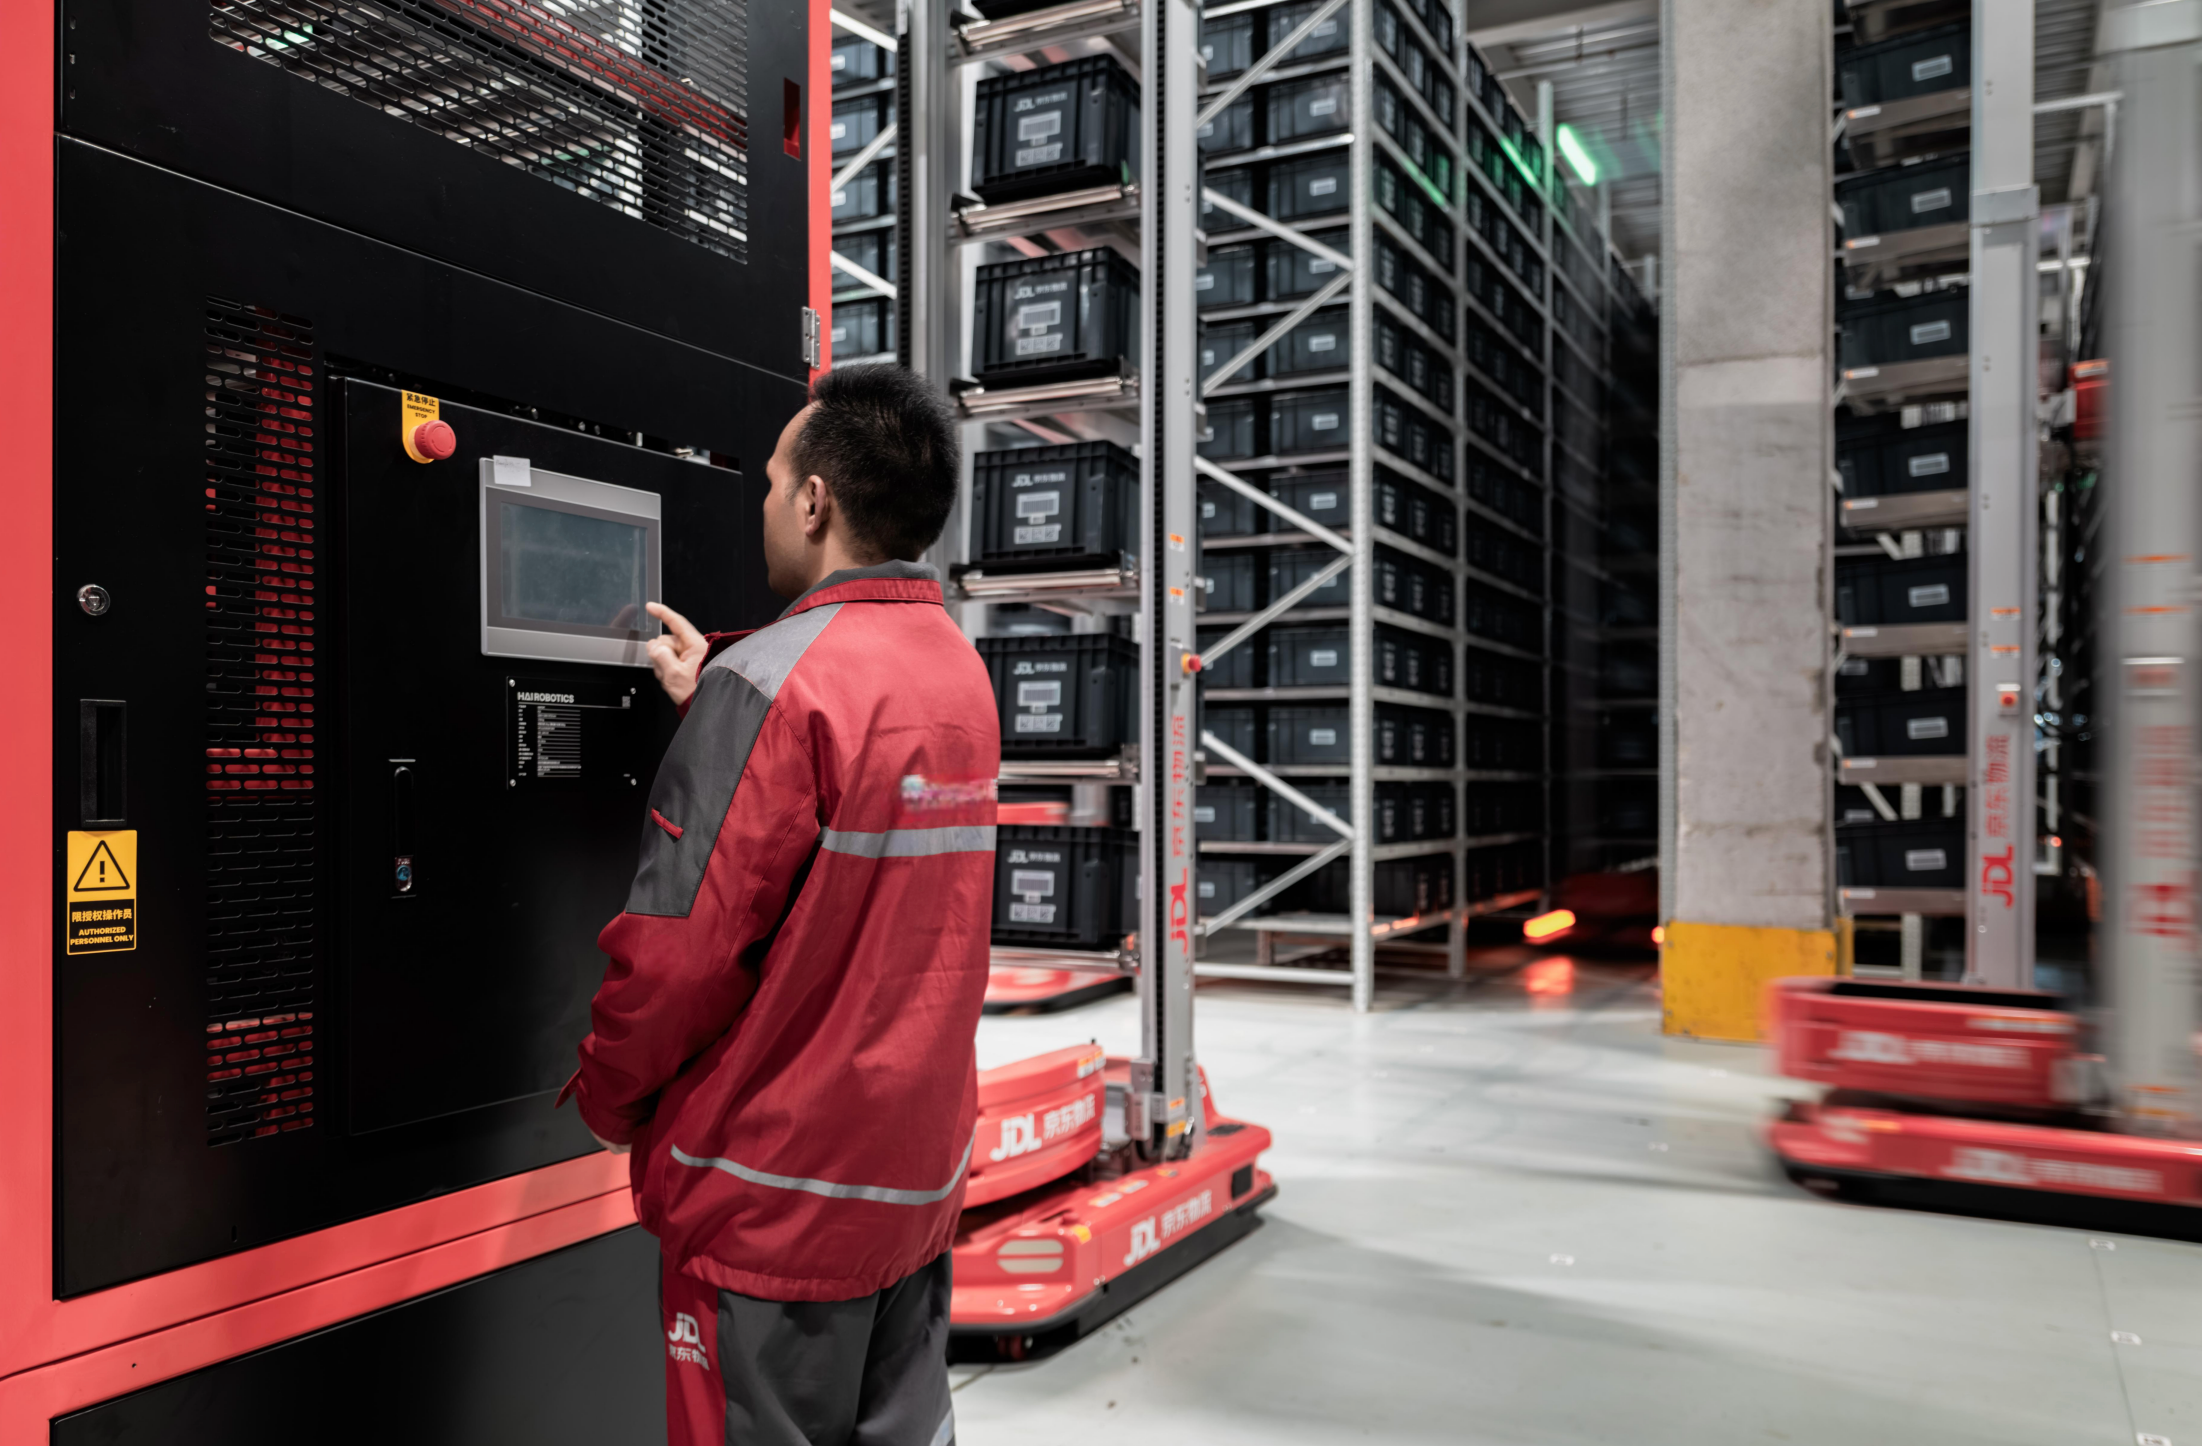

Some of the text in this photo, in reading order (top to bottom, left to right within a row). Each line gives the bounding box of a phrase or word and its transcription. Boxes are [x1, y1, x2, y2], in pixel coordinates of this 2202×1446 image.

[1013, 97, 1036, 112] JDL
[1013, 286, 1036, 300] JDL
[406, 392, 436, 407] 紧急停止
[406, 404, 436, 414] EMERGENCY
[1011, 474, 1034, 488] JDL
[1012, 661, 1035, 675] JDL
[534, 692, 575, 703] ROBOTICS
[1171, 714, 1185, 858] 京东物流
[1986, 734, 2009, 838] 京东物流
[1007, 849, 1029, 864] JDL
[1981, 844, 2015, 909] JDL
[71, 908, 133, 923] 限授权操作员
[1170, 867, 1188, 956] JDL
[78, 926, 127, 936] AUTHORIZED
[70, 934, 134, 946] PERSONNEL ONLY
[1043, 1093, 1096, 1141] 京东物流
[989, 1112, 1043, 1162] JDL
[1161, 1189, 1213, 1241] 京东物流
[1123, 1215, 1161, 1267] JDL
[668, 1311, 706, 1354] JDL
